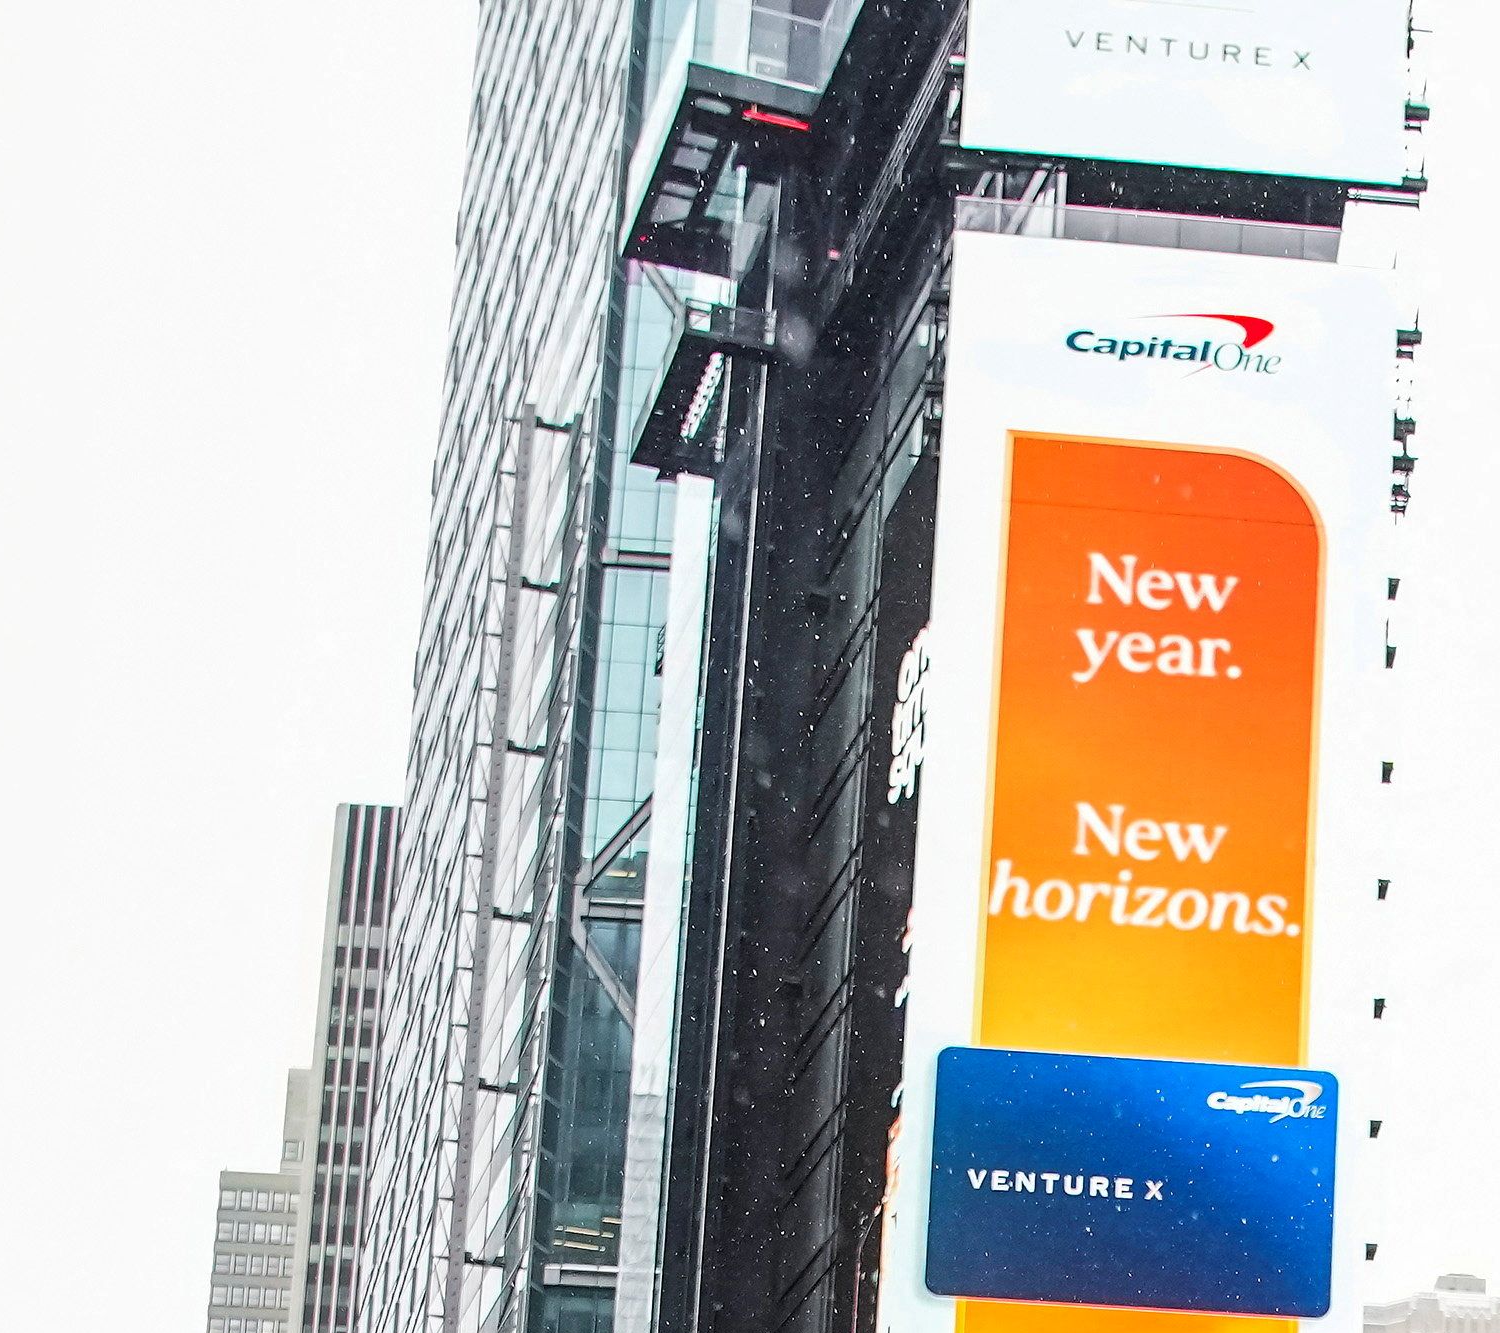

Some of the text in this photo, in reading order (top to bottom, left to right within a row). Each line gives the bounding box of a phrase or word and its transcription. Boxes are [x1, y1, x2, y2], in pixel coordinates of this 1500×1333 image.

[1065, 30, 1312, 71] VENTURE X
[1086, 552, 1241, 613] New
[1072, 627, 1243, 684] year.
[1072, 803, 1228, 864] New
[987, 859, 1301, 938] horizons.
[966, 1169, 1164, 1200] VENTURE X
